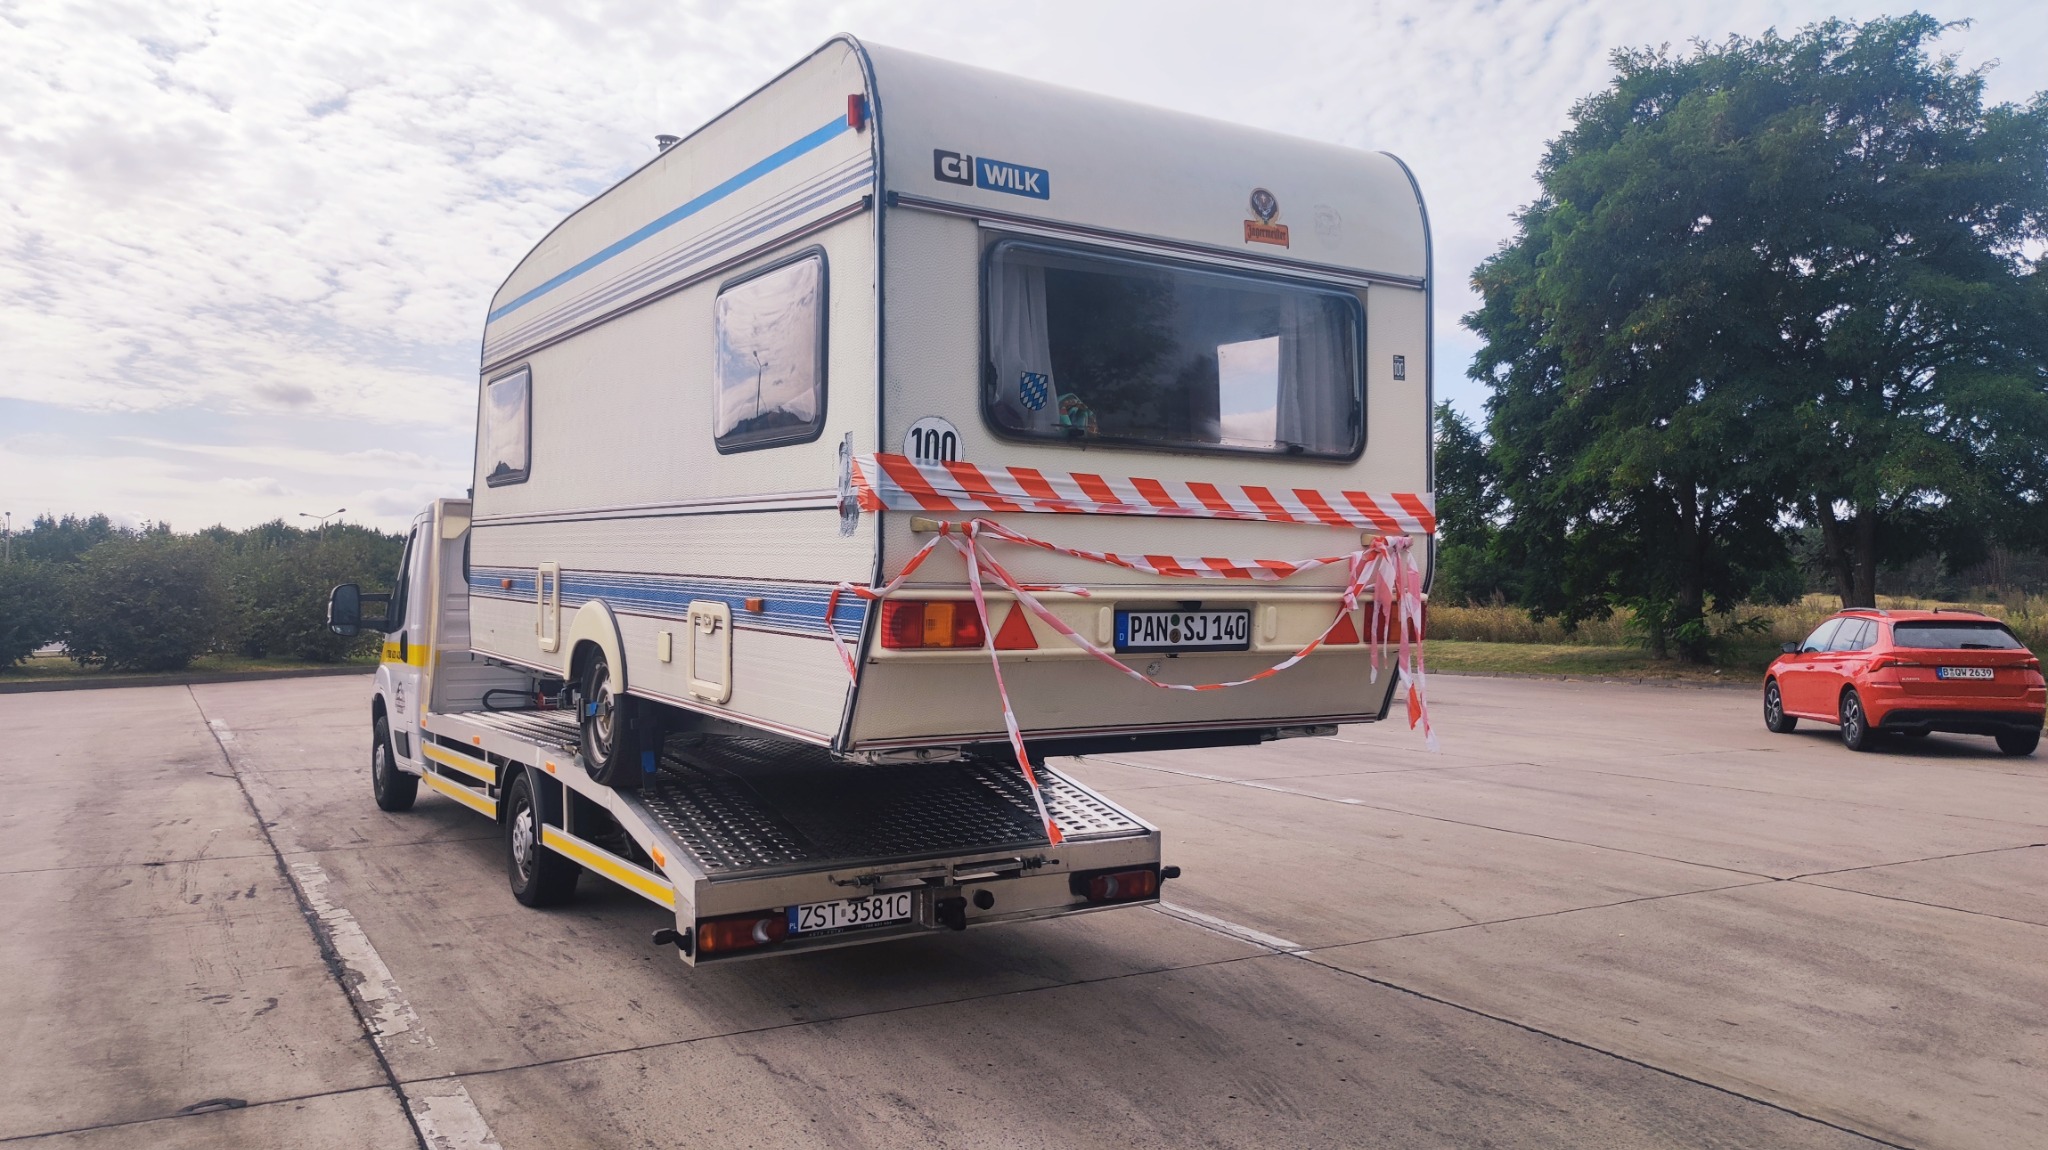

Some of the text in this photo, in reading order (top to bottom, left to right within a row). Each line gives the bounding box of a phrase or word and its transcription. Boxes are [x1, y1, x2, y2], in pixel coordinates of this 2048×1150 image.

[983, 163, 1041, 194] WILK
[912, 427, 956, 466] 100
[1119, 615, 1246, 642] D PAN SJ 140
[1943, 668, 1992, 677] B QW 2639
[789, 894, 908, 930] PL ZST 3581C
